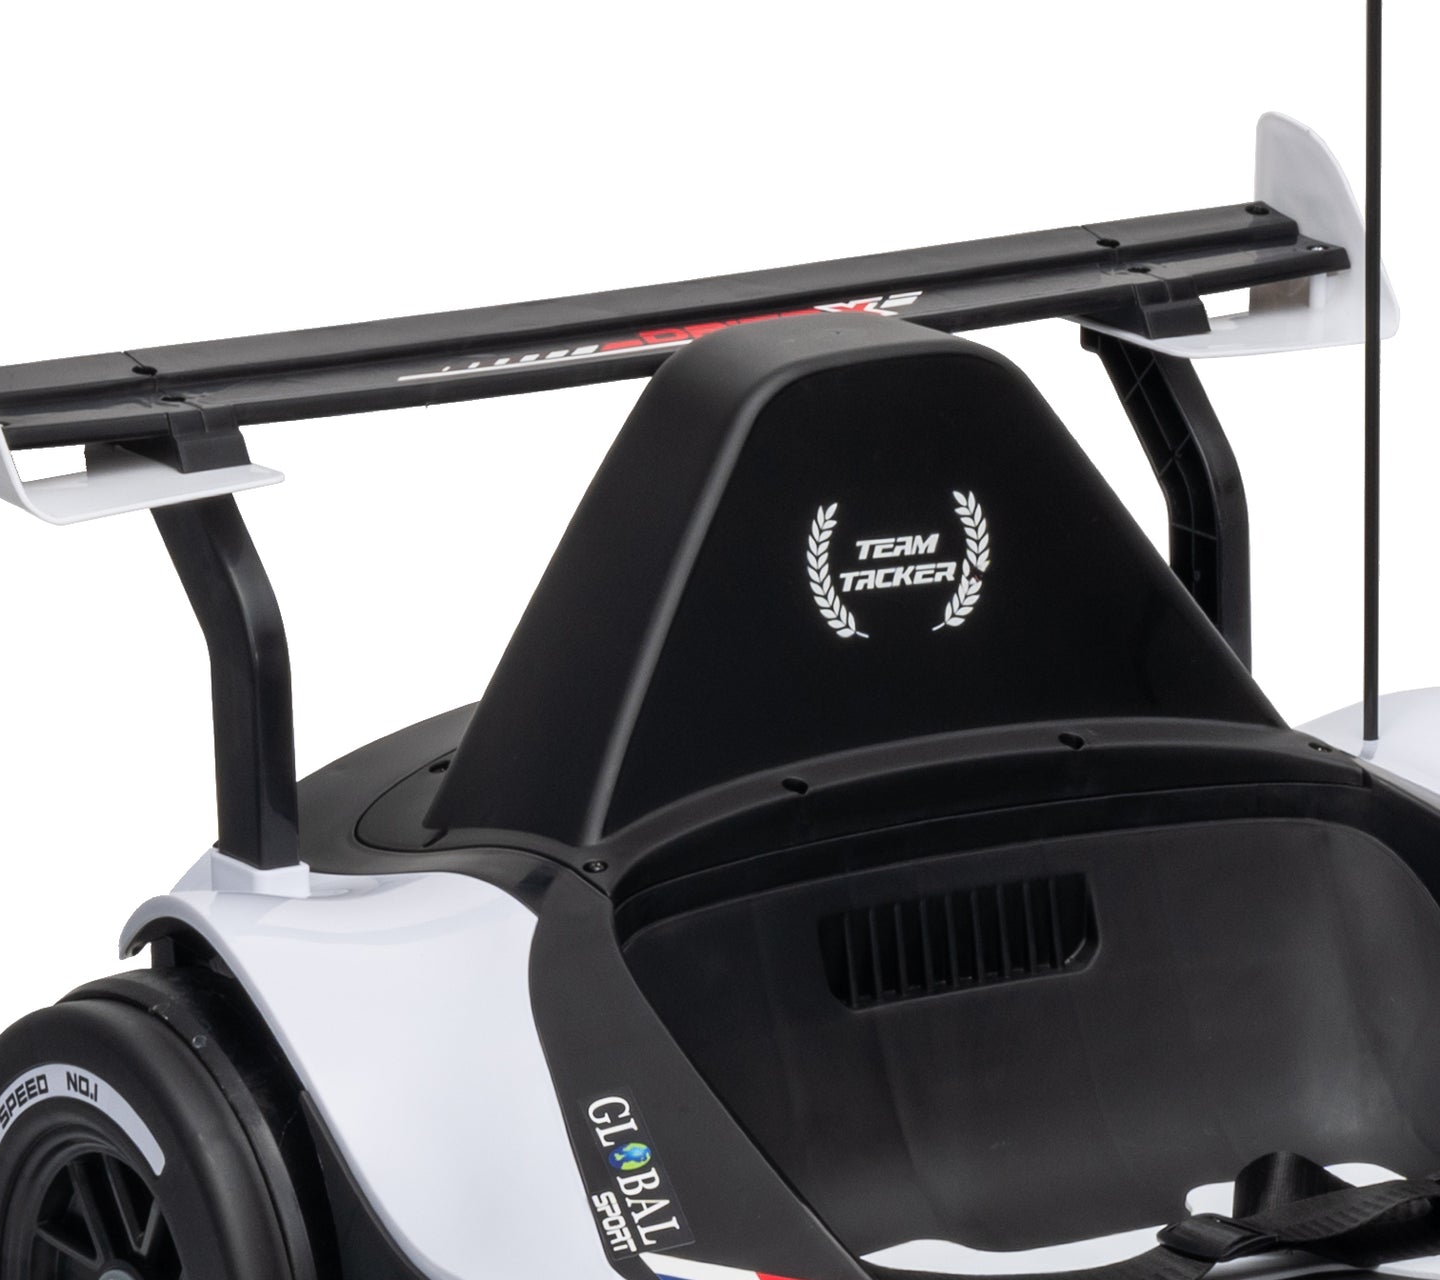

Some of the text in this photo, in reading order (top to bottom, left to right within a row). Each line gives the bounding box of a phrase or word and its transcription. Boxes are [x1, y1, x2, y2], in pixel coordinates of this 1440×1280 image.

[855, 533, 940, 560] TEAM
[839, 561, 957, 592] TACKER
[591, 1191, 637, 1252] SPORT
